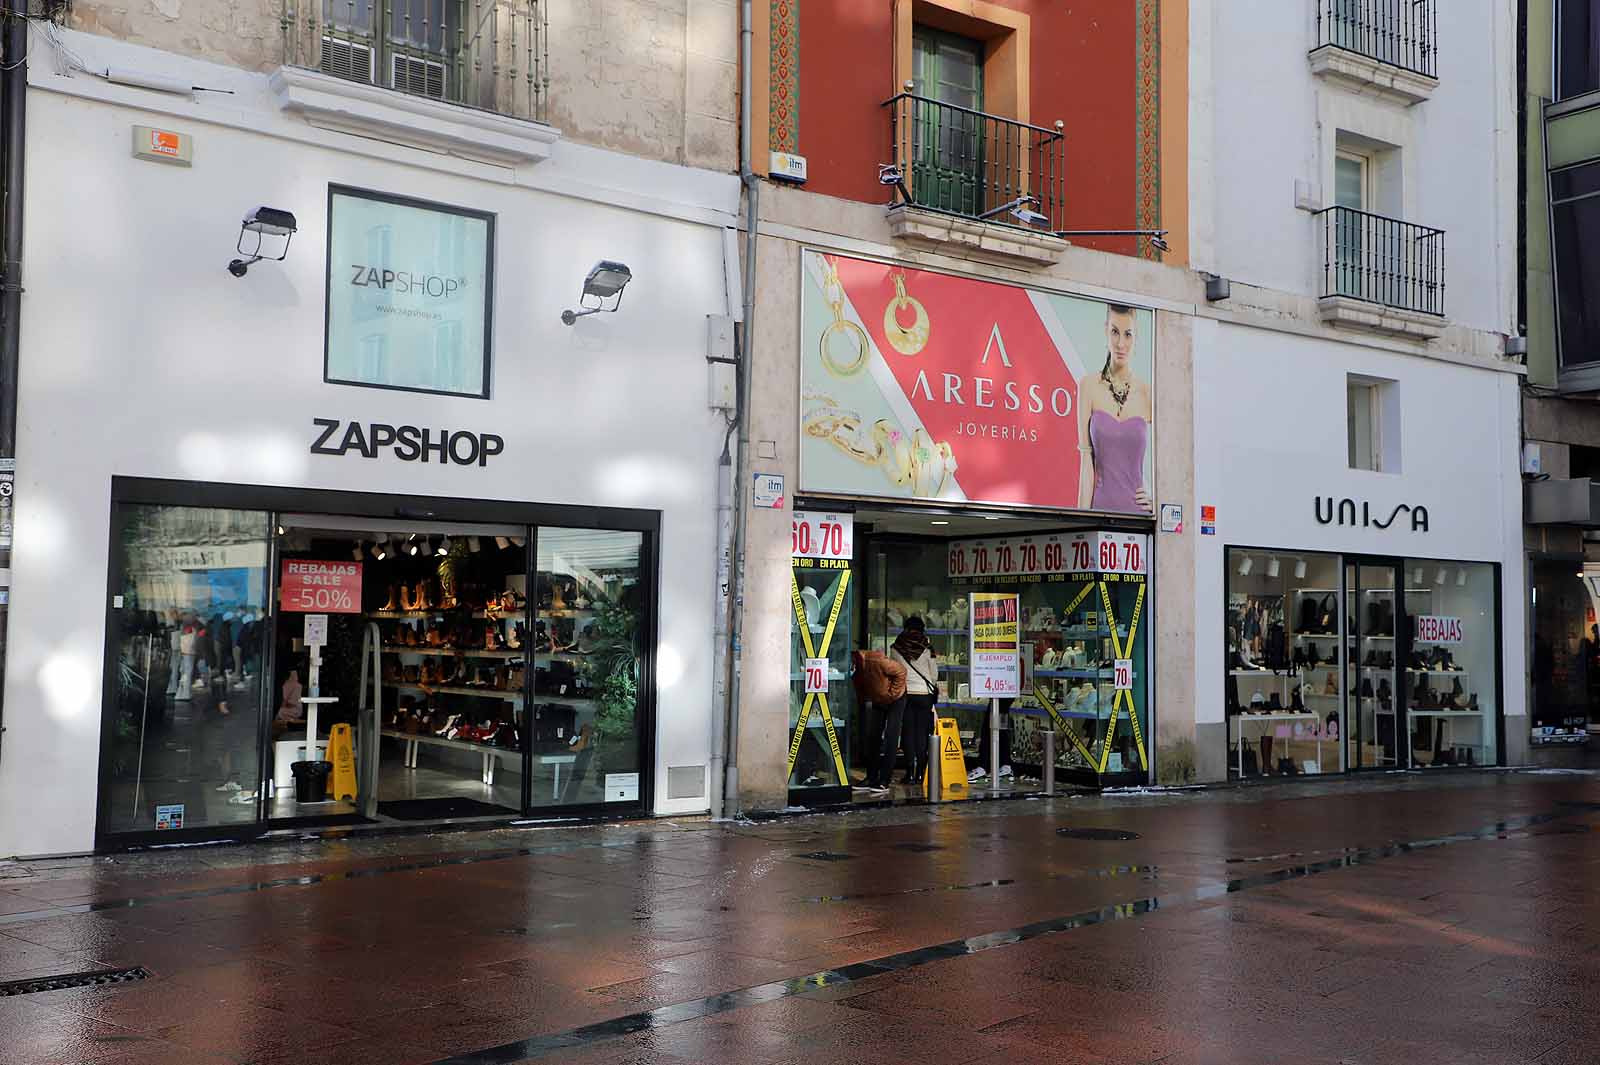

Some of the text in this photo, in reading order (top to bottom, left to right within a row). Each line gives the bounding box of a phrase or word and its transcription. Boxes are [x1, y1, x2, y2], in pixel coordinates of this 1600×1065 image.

[911, 369, 1073, 417] ARESSO
[310, 417, 505, 467] ZAPSHOP
[956, 421, 1039, 442] JOYERÍAS
[768, 479, 782, 490] itm
[820, 522, 842, 555] 70
[800, 558, 814, 568] ORO
[820, 560, 828, 568] EN
[830, 560, 849, 568] PLATA
[950, 541, 1089, 574] 60 70 70 70 60 70
[1100, 541, 1140, 571] 60 70
[288, 563, 357, 576] REBAJAS
[302, 575, 342, 586] SALE
[1080, 573, 1094, 581] PLATA
[1104, 574, 1109, 582] EN
[291, 588, 352, 609] -50%
[830, 584, 845, 623] ALMACENES
[1004, 599, 1016, 622] YA
[1420, 618, 1462, 641] REBAJAS
[806, 668, 822, 689] 70
[1116, 668, 1127, 686] 70
[788, 728, 802, 764] VACIAMOS
[824, 718, 841, 758] ALMACENES
